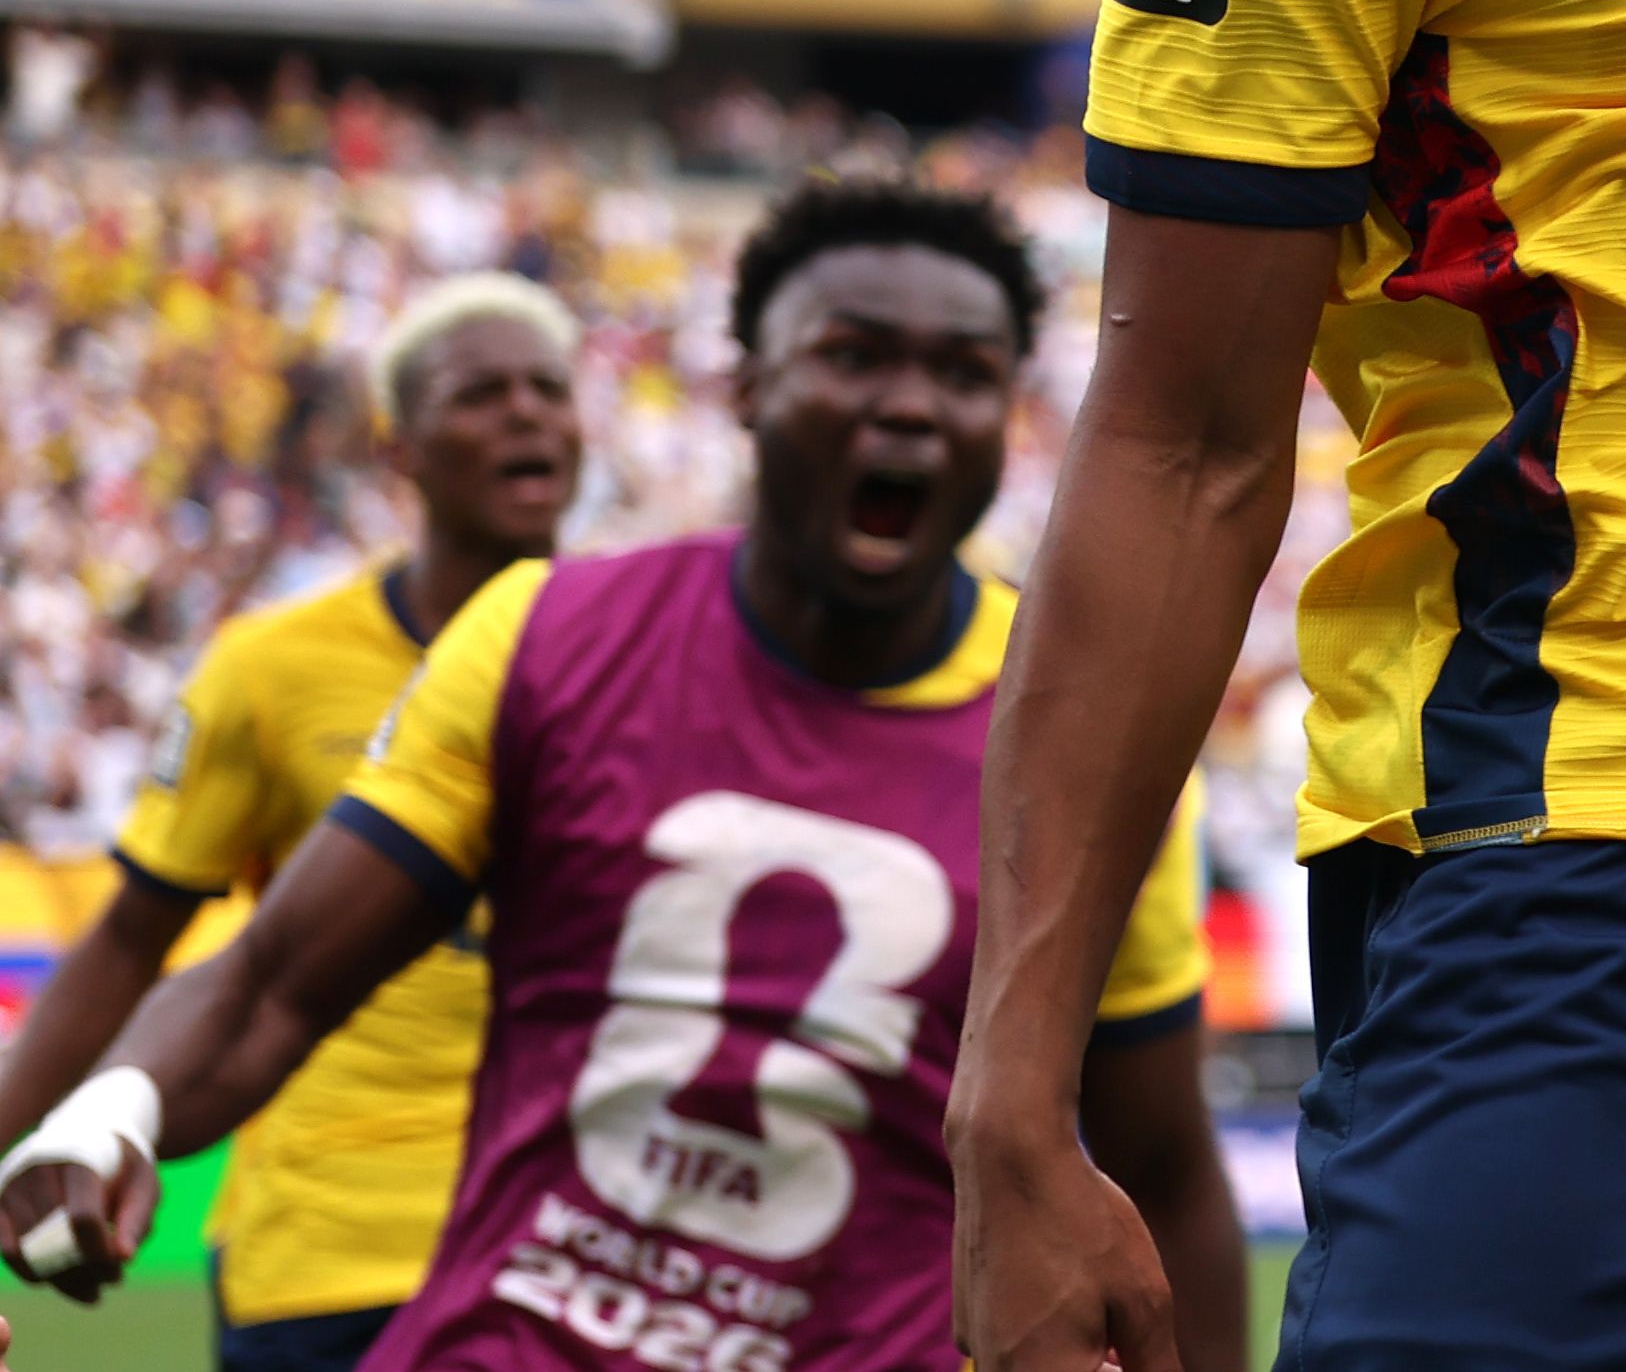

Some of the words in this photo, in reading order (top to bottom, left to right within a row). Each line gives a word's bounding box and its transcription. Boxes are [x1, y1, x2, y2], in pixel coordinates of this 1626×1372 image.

[642, 1134, 763, 1209] FIFA
[492, 1241, 794, 1372] 2026
[534, 1191, 705, 1295] WORLD
[706, 1263, 812, 1328] CUP
